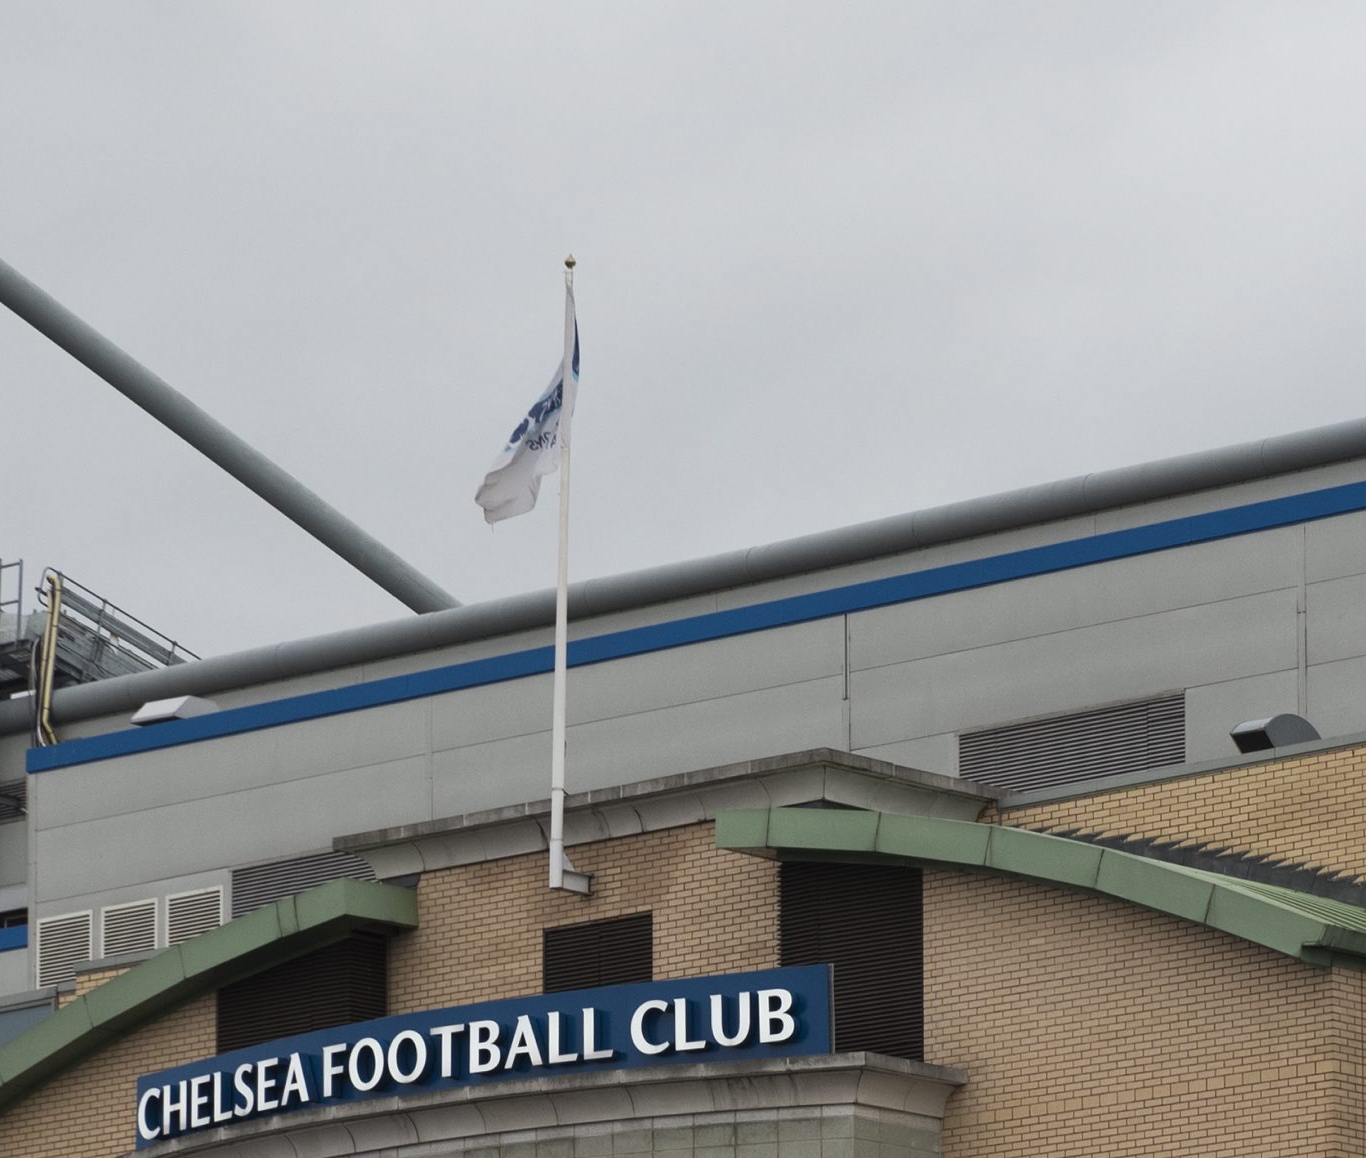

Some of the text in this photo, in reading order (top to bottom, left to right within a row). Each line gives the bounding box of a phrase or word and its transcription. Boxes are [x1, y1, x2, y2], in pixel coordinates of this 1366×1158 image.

[137, 988, 796, 1141] CHELSEA FOOTBALL CLUB
